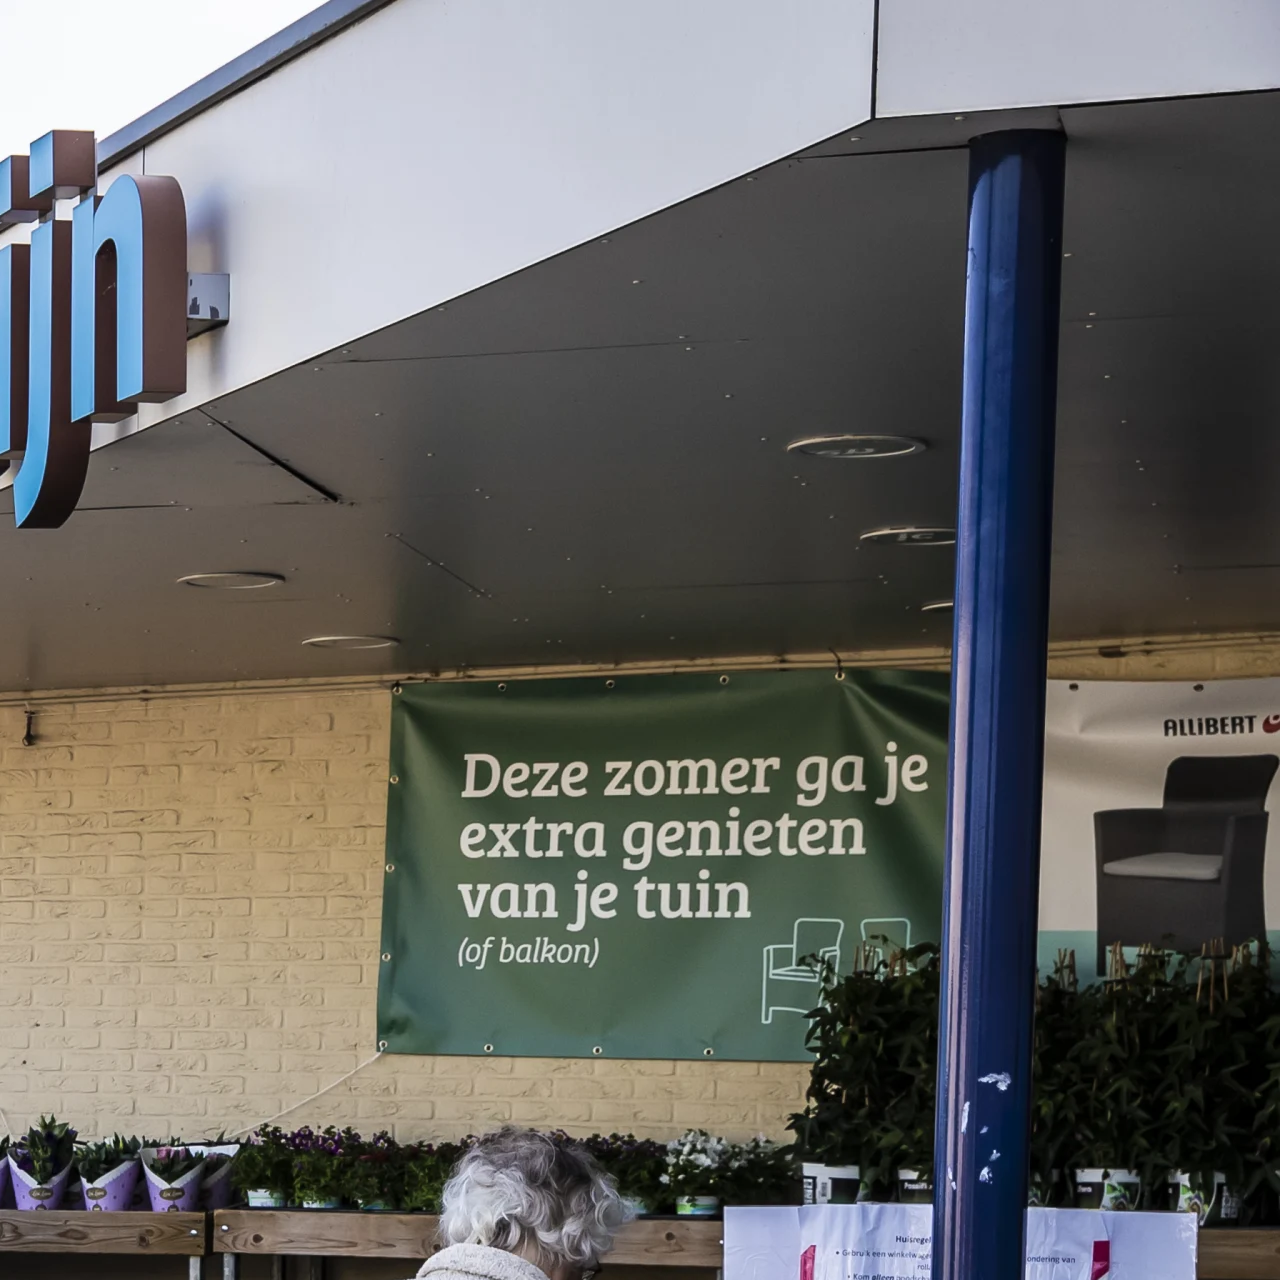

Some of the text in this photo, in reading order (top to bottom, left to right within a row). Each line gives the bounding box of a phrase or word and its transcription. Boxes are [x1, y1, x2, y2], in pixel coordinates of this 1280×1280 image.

[461, 742, 929, 806] Deze zomer ga je
[459, 806, 867, 869] extra genieten
[457, 870, 751, 932] van je tuin
[457, 935, 600, 968] (of balkon)
[872, 1273, 894, 1280] alleen
